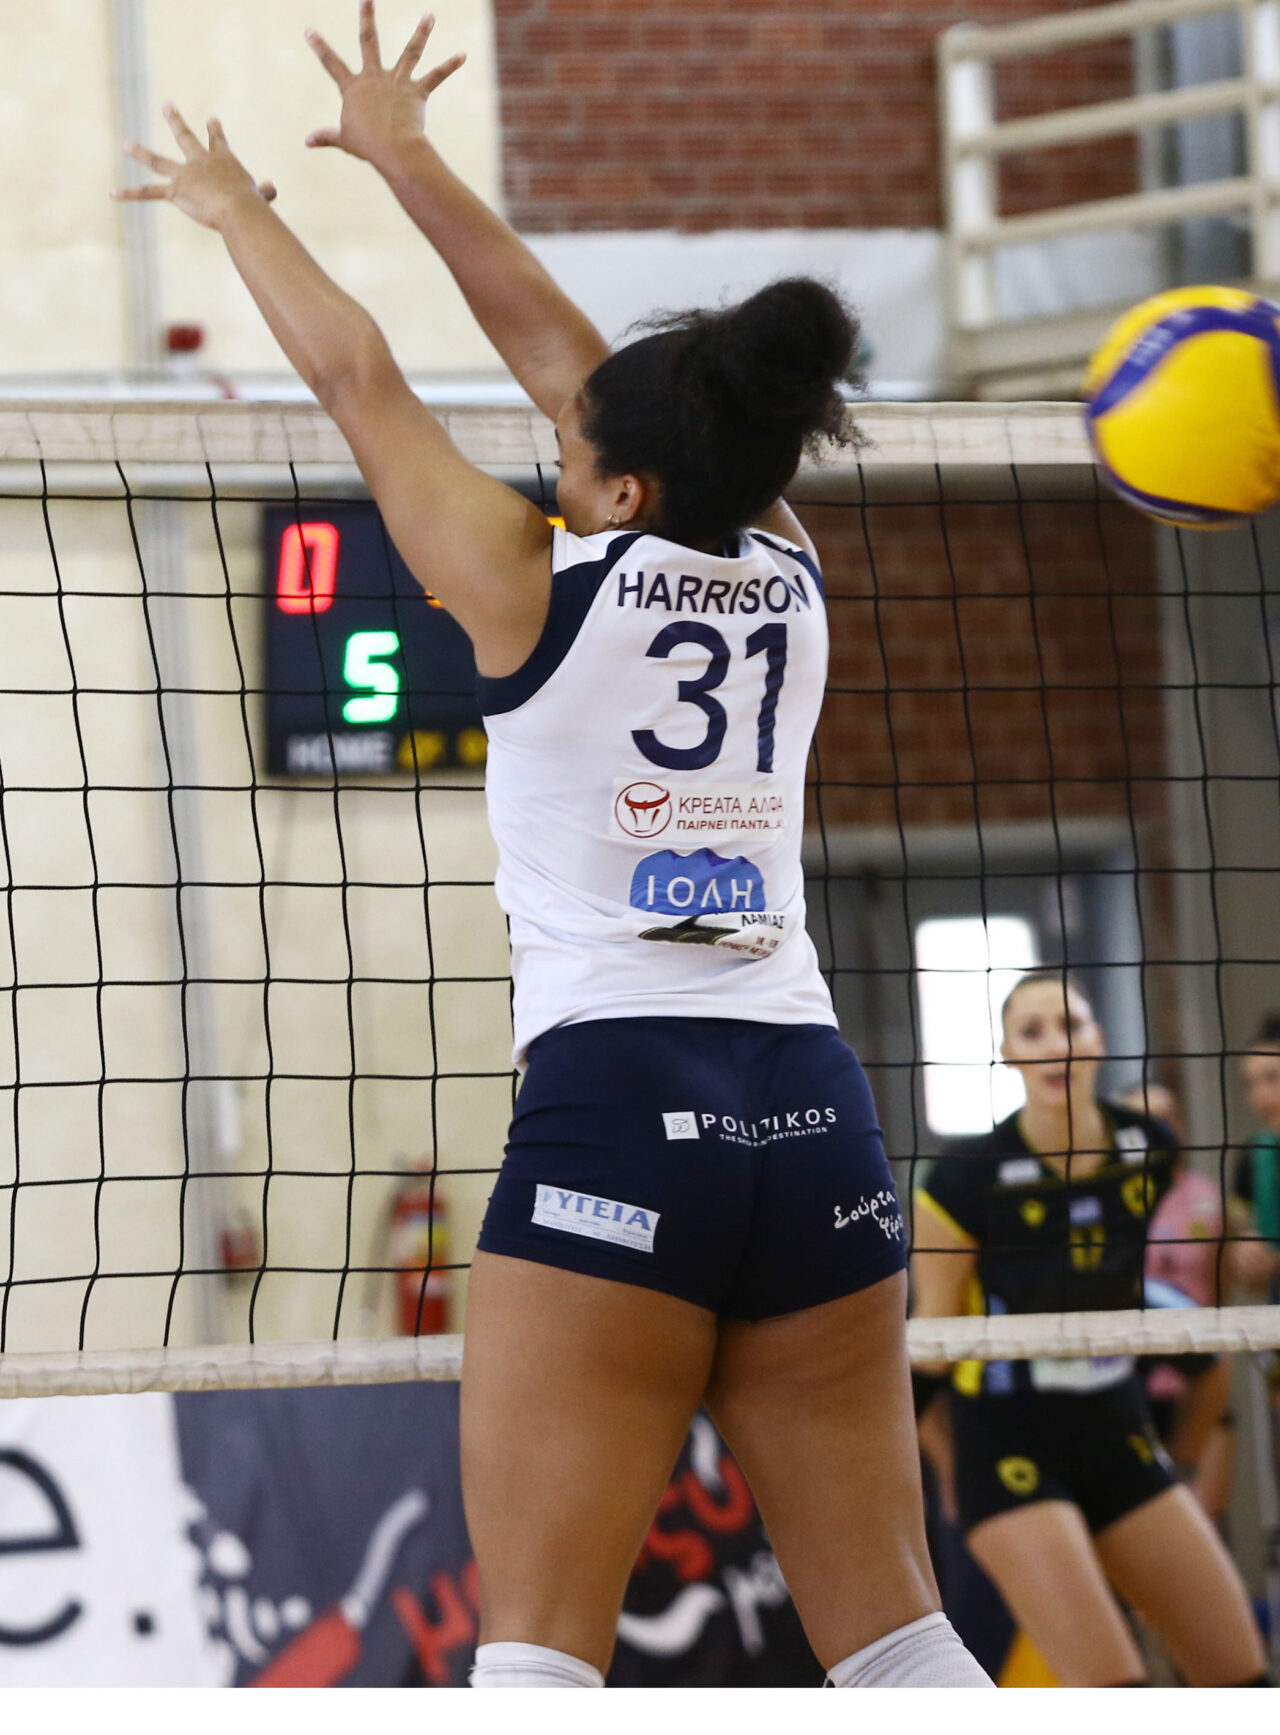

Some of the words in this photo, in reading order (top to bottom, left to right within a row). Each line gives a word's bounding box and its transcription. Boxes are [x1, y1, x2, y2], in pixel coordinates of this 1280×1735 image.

[277, 521, 339, 614] 0
[617, 571, 811, 614] HARRISON
[343, 631, 400, 723] 5
[631, 620, 787, 773] 31
[677, 820, 727, 830] ΠΑΙΡΝΕΙ
[679, 797, 742, 813] ΚΡΕΑΤΑ
[647, 875, 753, 908] ΙΟΛΗ
[701, 1108, 837, 1139] POLITIKOS
[557, 1190, 652, 1232] ΥΓΕΙΑ
